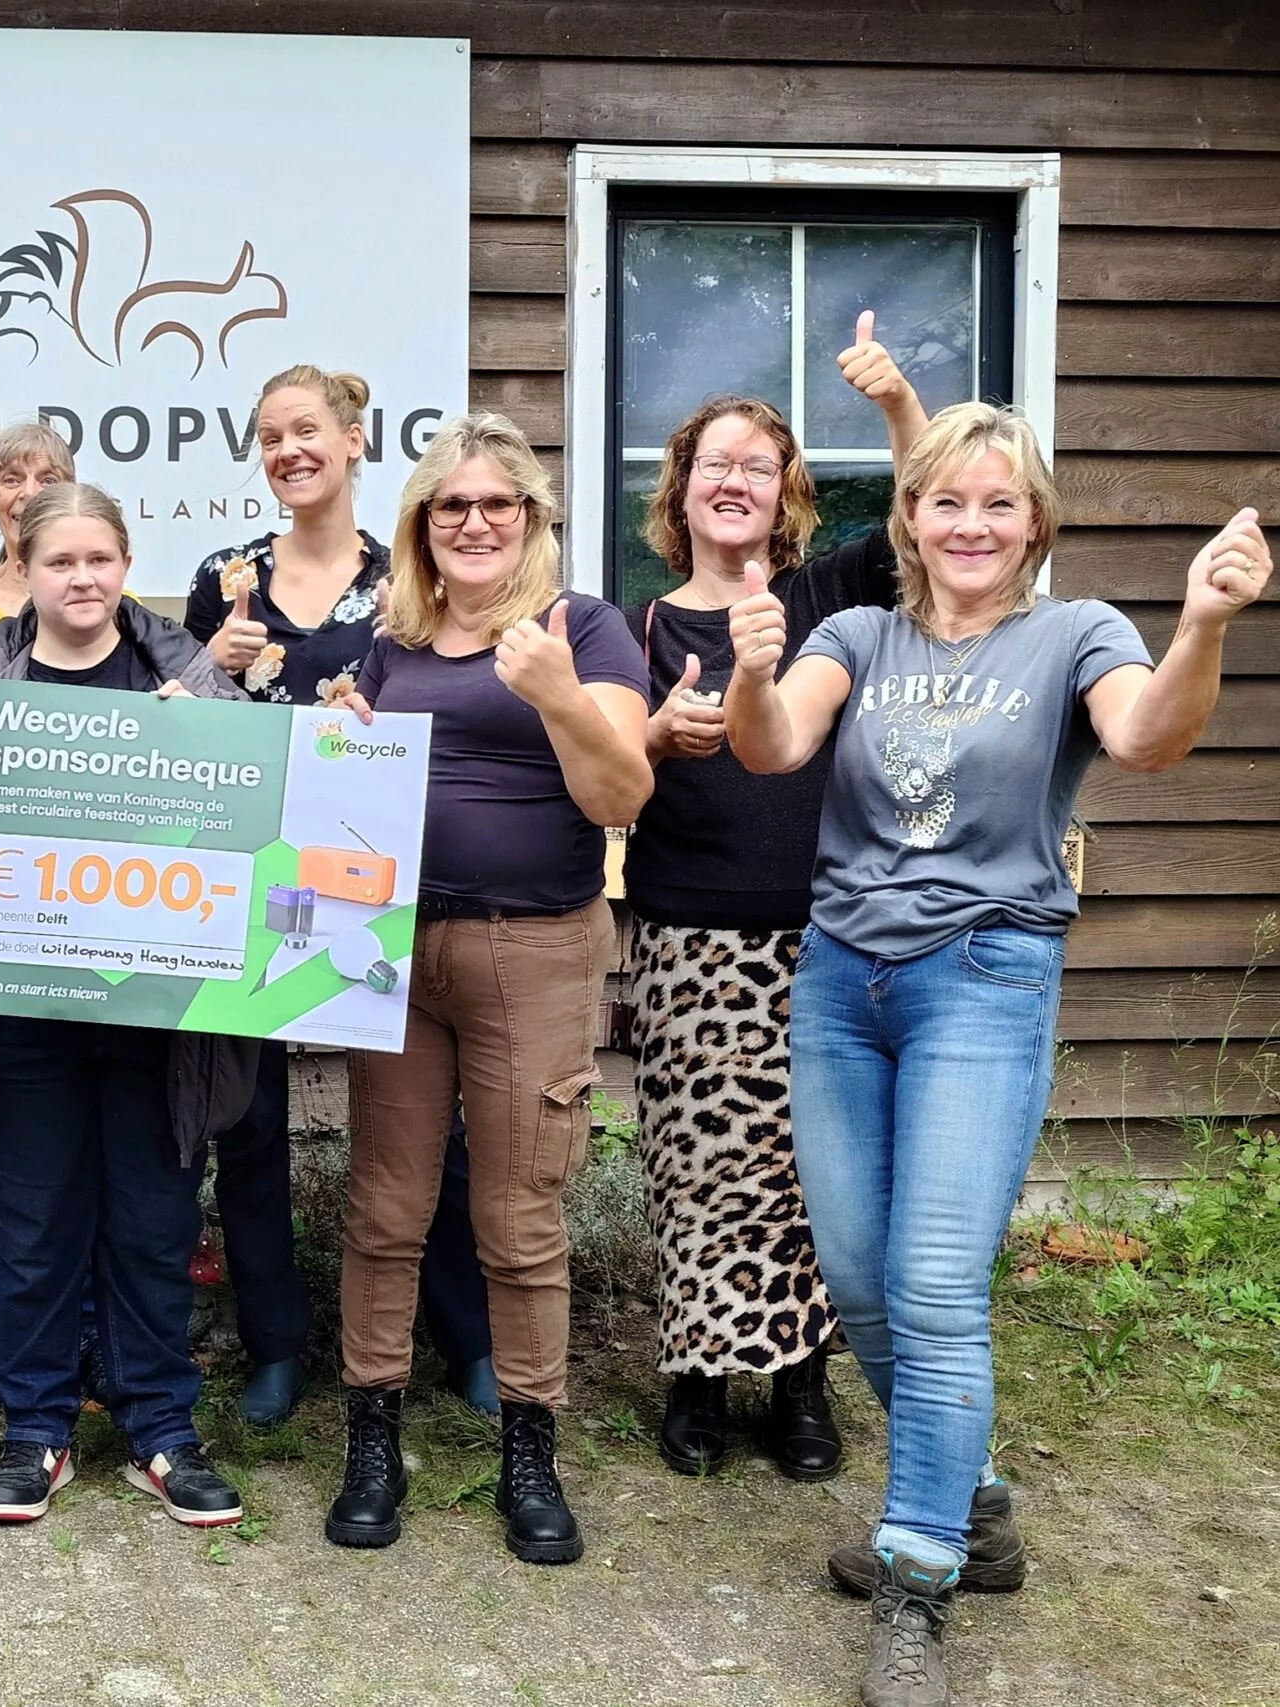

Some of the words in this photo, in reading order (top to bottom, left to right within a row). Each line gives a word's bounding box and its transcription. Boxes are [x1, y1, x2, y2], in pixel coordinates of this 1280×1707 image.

[855, 674, 1031, 722] REBELLE
[883, 699, 914, 725] Le
[914, 702, 995, 730] Sauvage
[331, 739, 407, 760] Wecycle
[26, 785, 70, 801] maken
[73, 790, 93, 802] we
[96, 792, 120, 804] van
[123, 792, 203, 813] Koningsdag
[206, 799, 224, 813] de
[19, 803, 81, 818] circulaire
[84, 806, 145, 826] feestdag
[148, 814, 172, 826] van
[175, 814, 198, 828] het
[197, 816, 233, 831] jaar!
[34, 852, 237, 923] 1.000,-
[36, 912, 68, 925] Delft
[13, 941, 38, 954] doel
[140, 949, 245, 971] Haaglanden
[4, 983, 20, 994] en
[19, 982, 47, 996] start
[48, 984, 68, 998] iets
[69, 986, 109, 1001] nieuws
